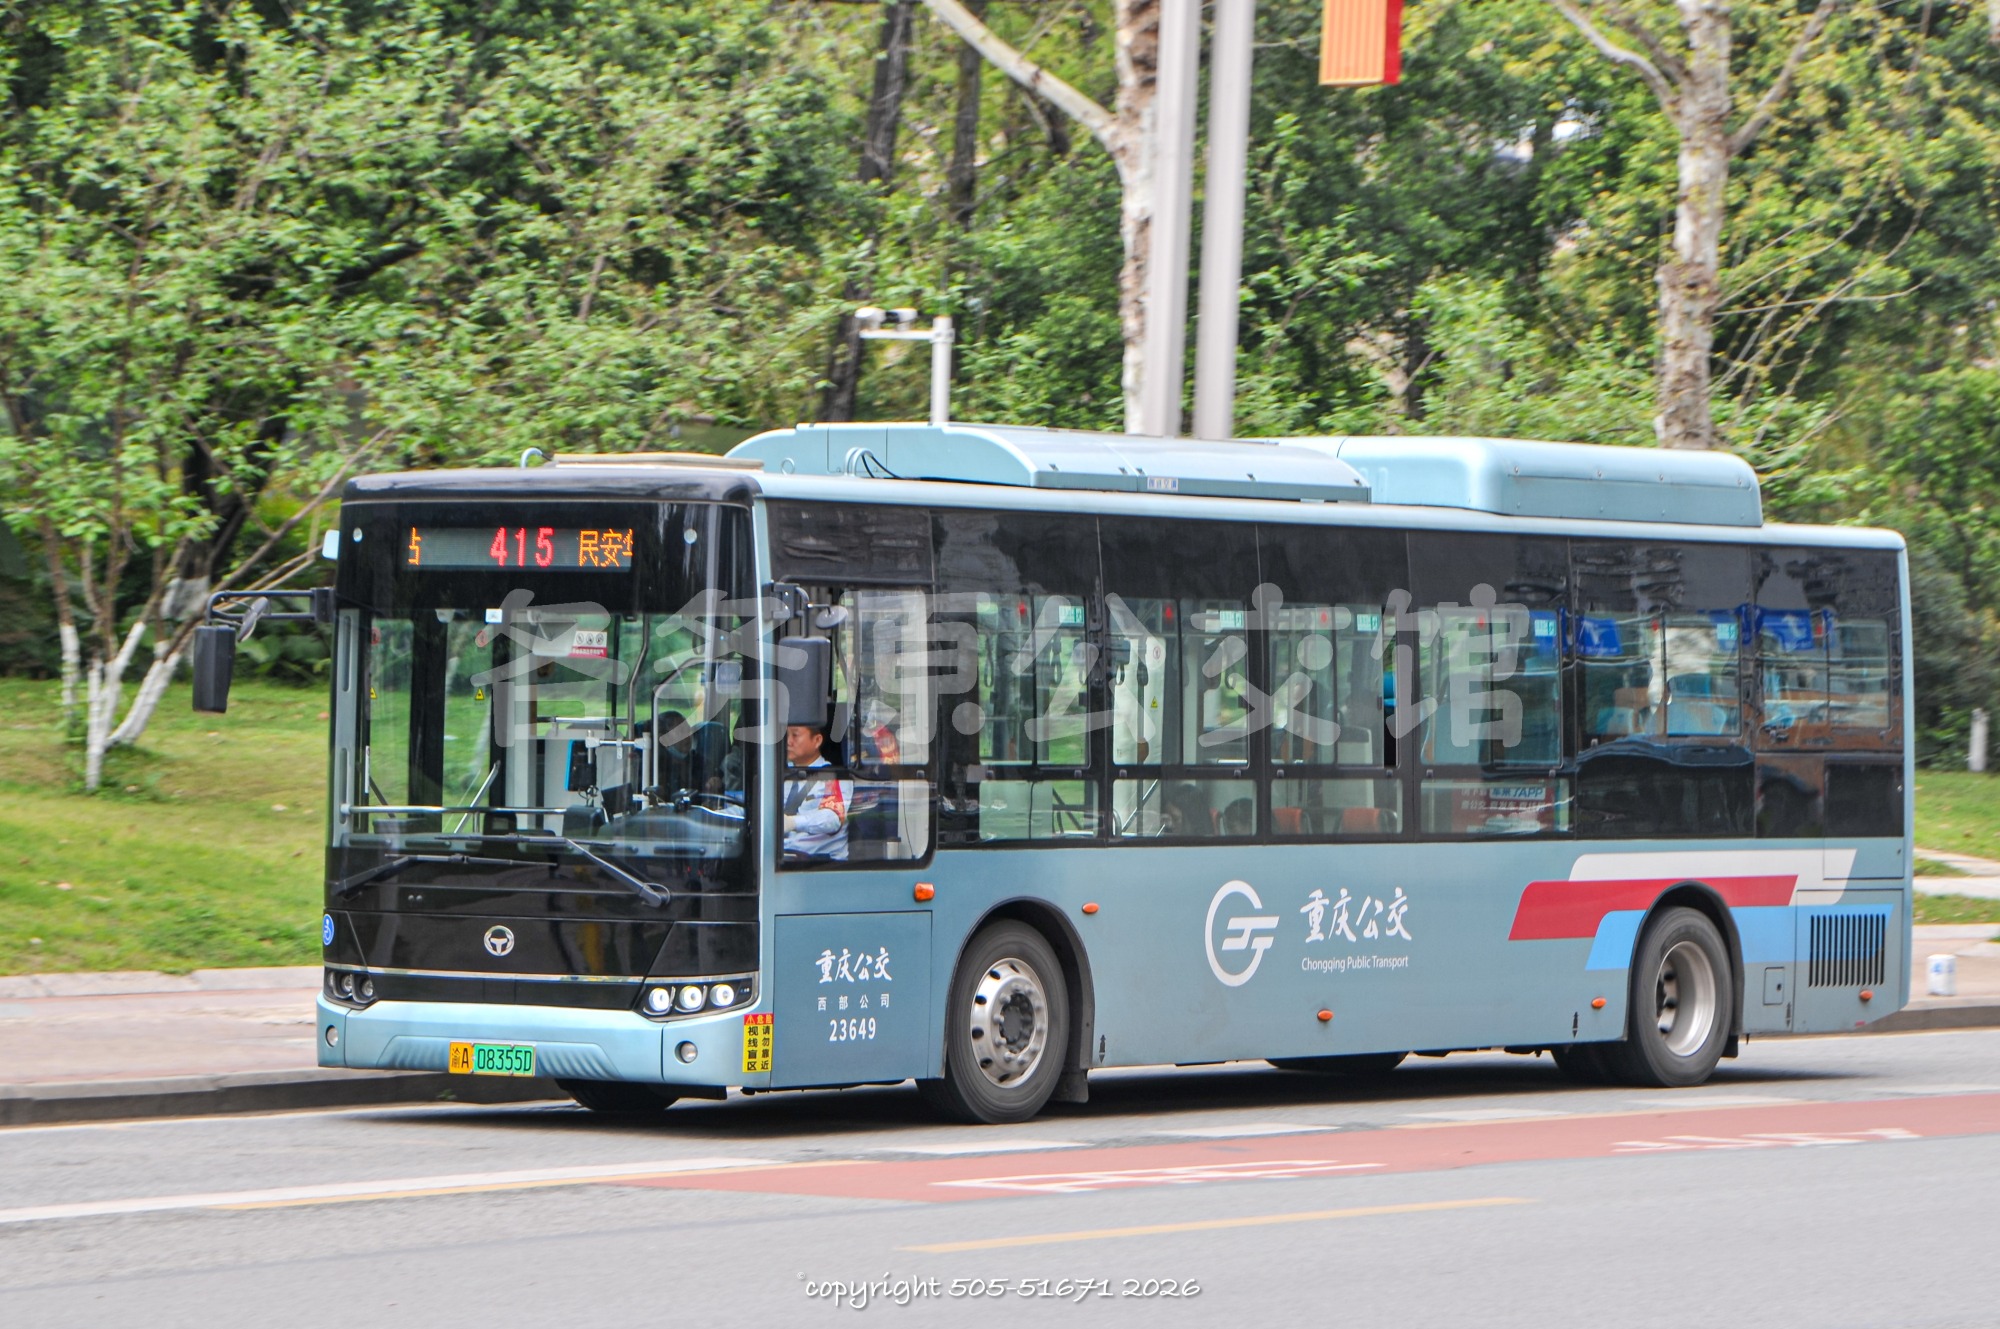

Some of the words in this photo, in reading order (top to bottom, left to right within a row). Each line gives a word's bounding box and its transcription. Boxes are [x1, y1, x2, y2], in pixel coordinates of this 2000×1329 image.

[490, 527, 554, 567] 415
[1300, 887, 1412, 943] 重庆公交
[815, 947, 892, 983] 重庆公交
[1301, 957, 1345, 973] Chongqing
[1347, 956, 1371, 969] Public
[1372, 955, 1409, 971] Transport
[817, 993, 890, 1011] 西部公司
[829, 1017, 876, 1041] 23649
